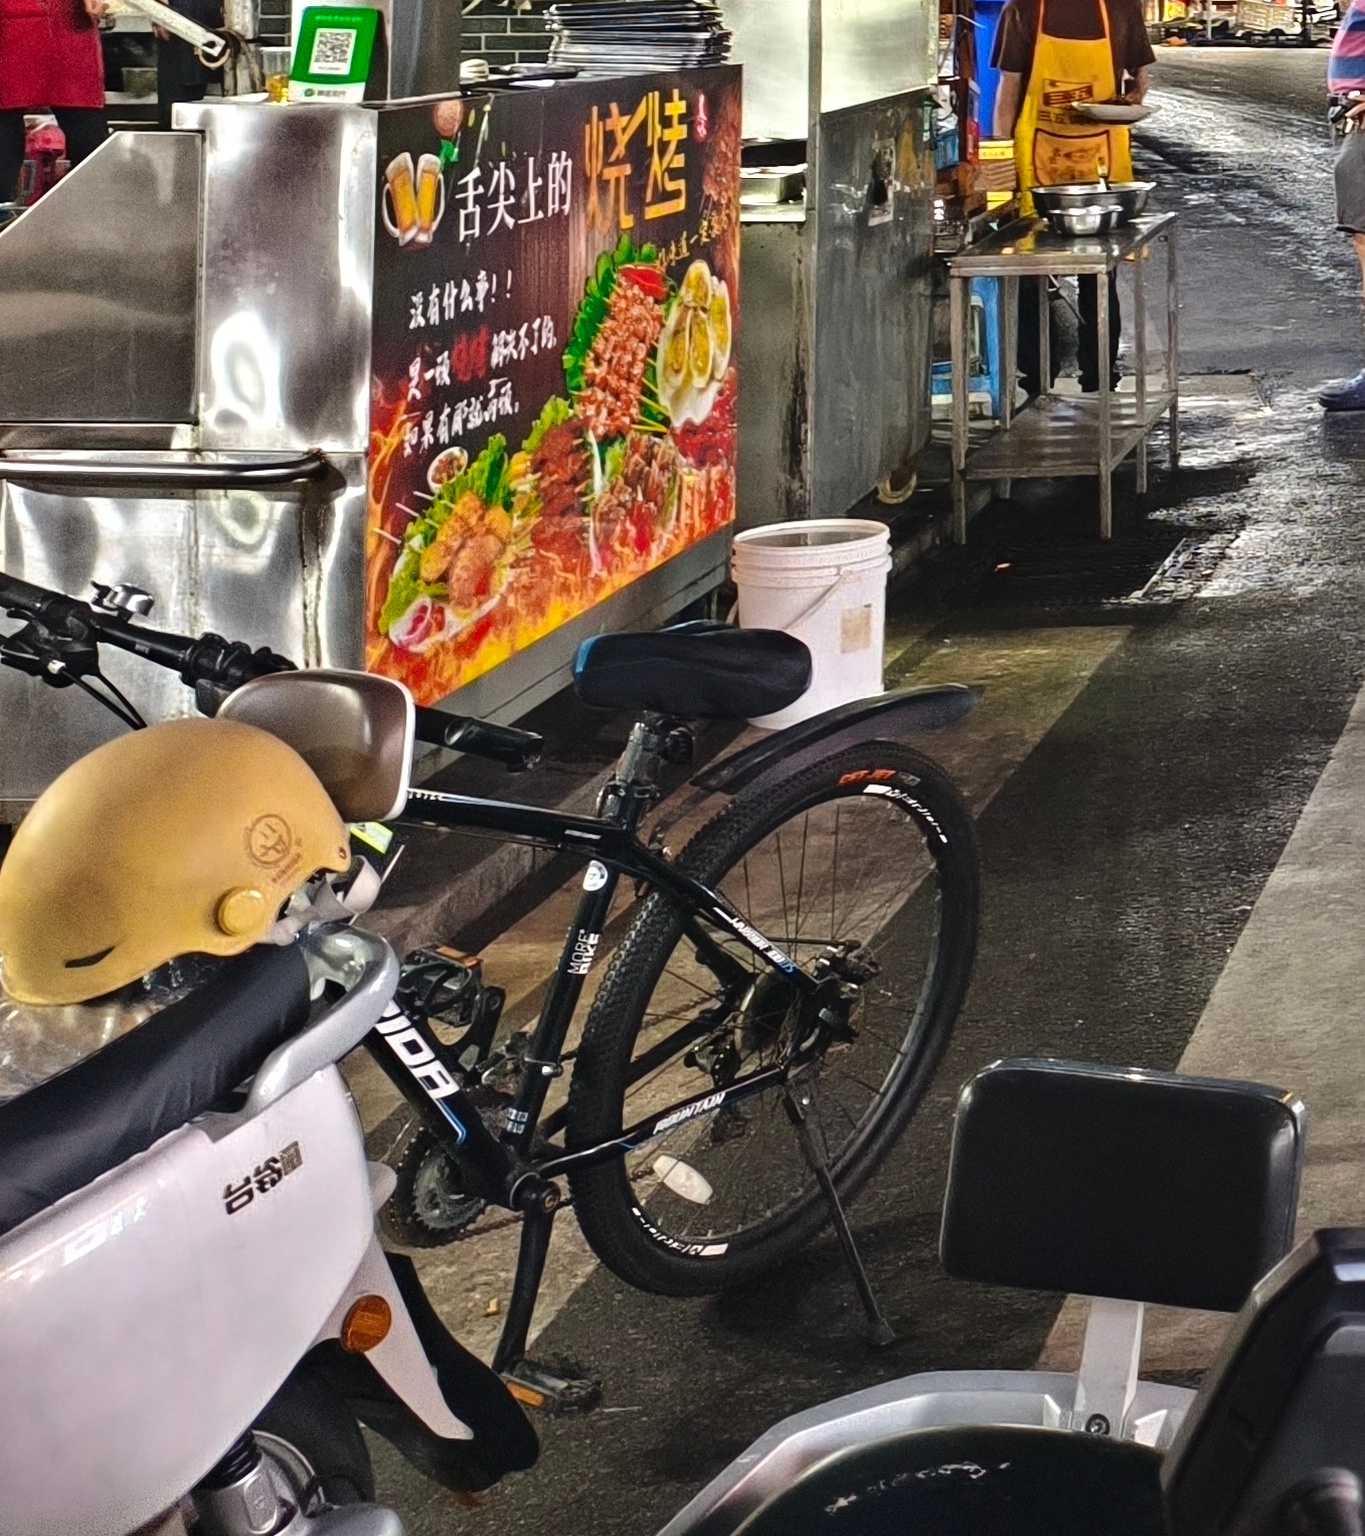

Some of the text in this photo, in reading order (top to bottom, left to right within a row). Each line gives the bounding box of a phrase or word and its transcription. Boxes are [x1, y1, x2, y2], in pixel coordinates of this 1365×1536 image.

[455, 150, 573, 243] 舌尖上的
[584, 89, 688, 234] 烧烤
